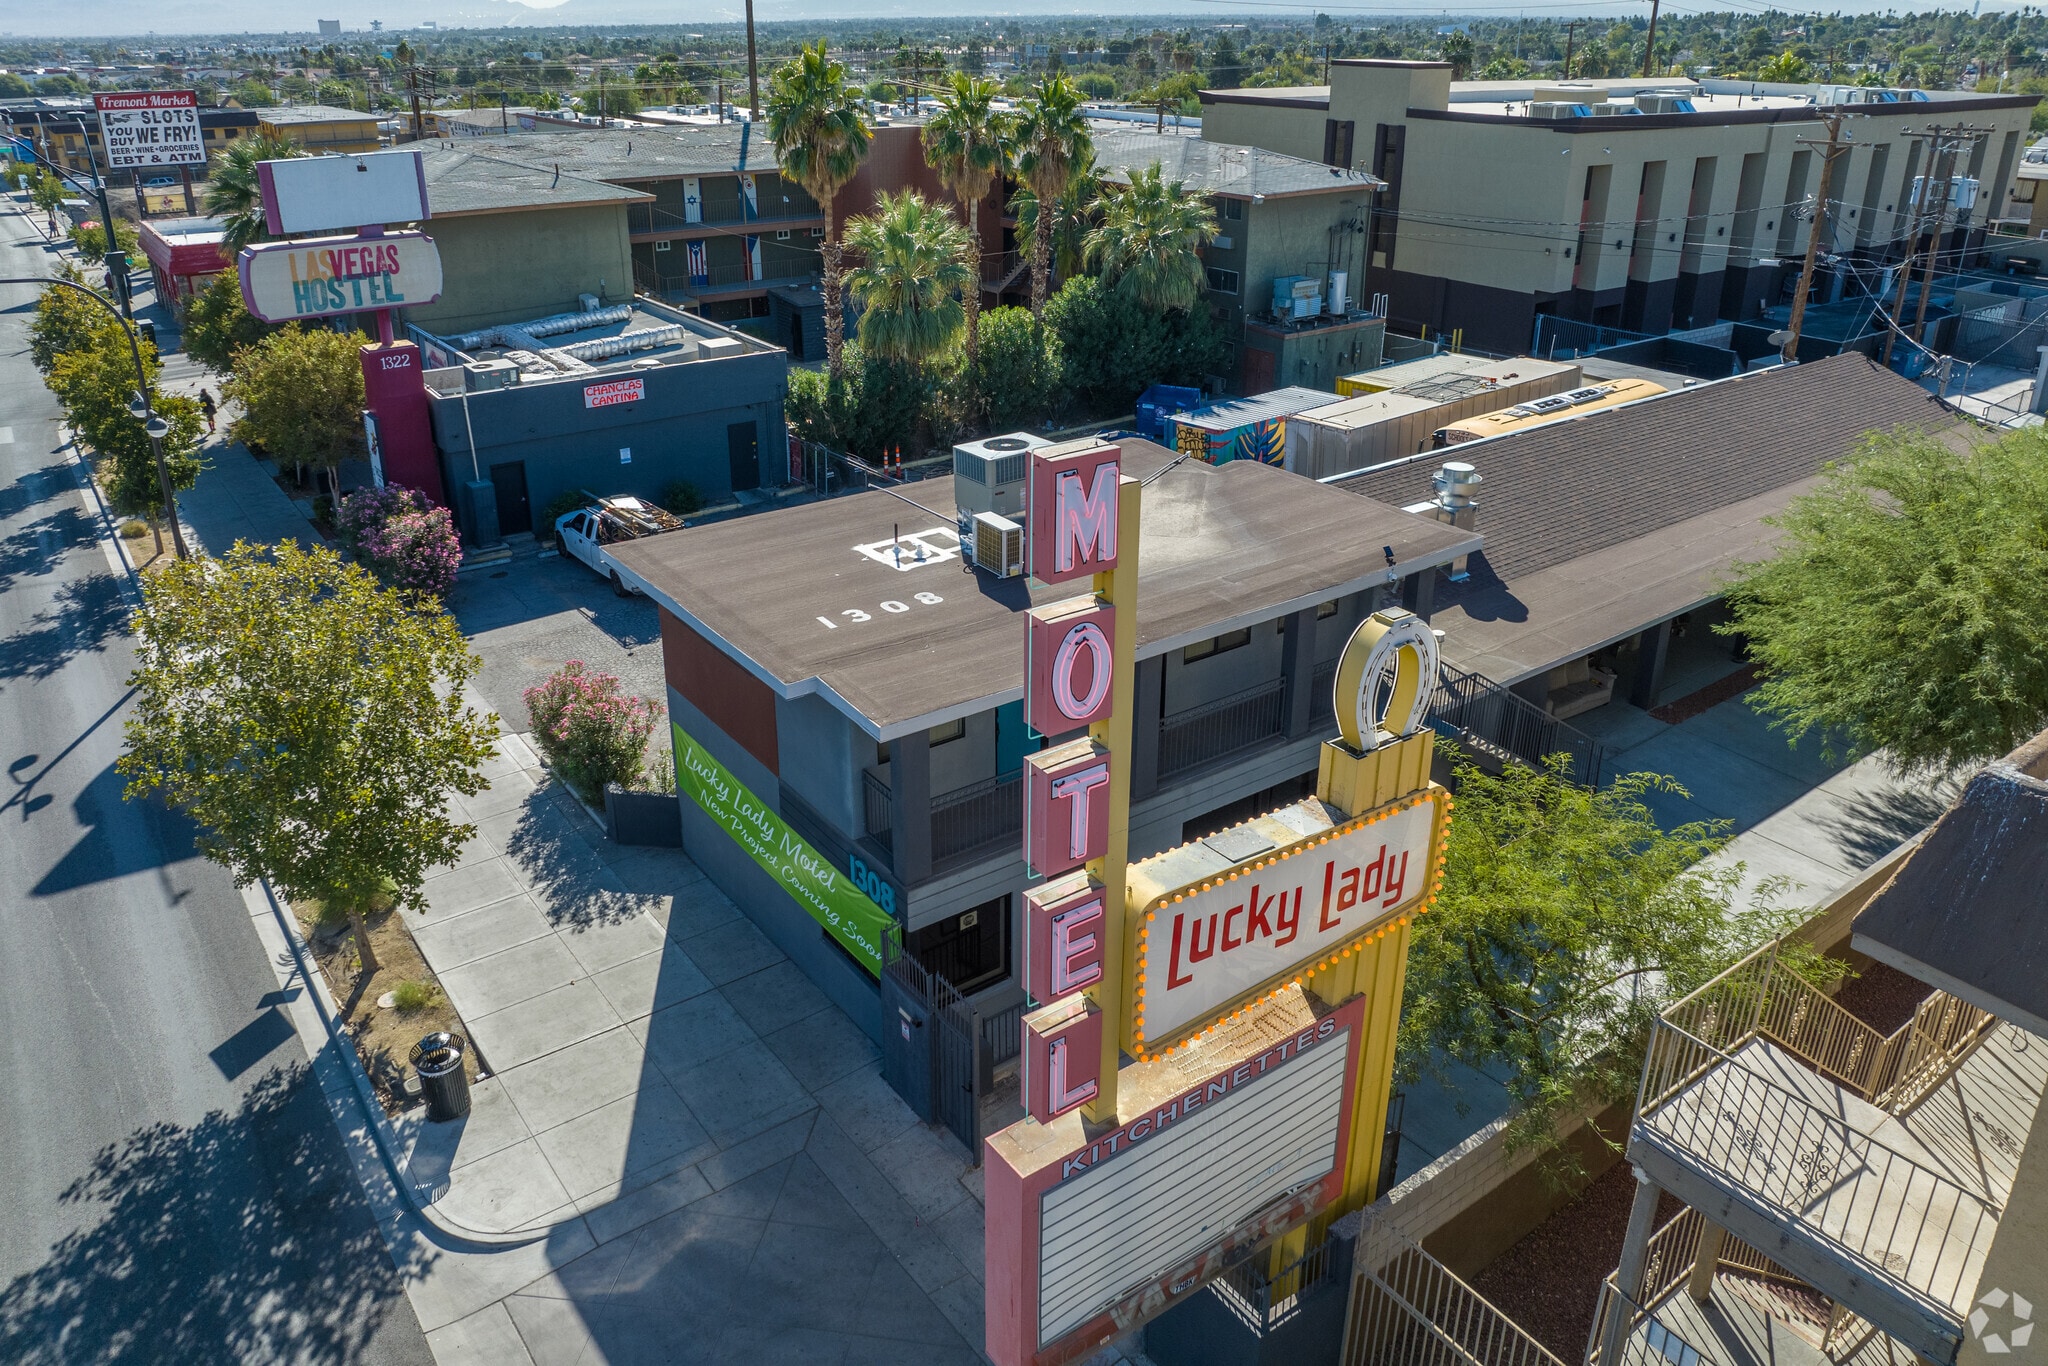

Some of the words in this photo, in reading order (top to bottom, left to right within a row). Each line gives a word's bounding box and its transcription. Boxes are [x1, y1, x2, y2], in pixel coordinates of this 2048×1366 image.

[101, 96, 149, 108] Fremont
[150, 95, 191, 107] Market
[141, 109, 194, 124] SLOTS
[107, 127, 133, 136] YOU
[136, 127, 159, 143] WE
[164, 126, 197, 142] FRY!
[110, 137, 135, 146] BUY
[159, 144, 200, 152] GROCERIES
[112, 155, 144, 165] EBT
[151, 154, 162, 163] &
[169, 152, 202, 162] ATM
[292, 270, 405, 314] HOSTEL
[380, 354, 411, 370] 1322
[586, 380, 642, 396] CHANCLAS
[591, 391, 639, 407] CANTINA
[815, 592, 944, 629] 1308
[1049, 461, 1118, 1115] MOTEL
[685, 747, 729, 803] Lucky
[734, 789, 776, 845] Lady
[779, 832, 836, 893] Motel
[700, 788, 728, 820] New
[730, 814, 779, 869] Project
[781, 865, 841, 929] Coming
[850, 854, 896, 915] 1308
[1167, 884, 1302, 991] Lucky
[1318, 844, 1409, 933] Lady
[1062, 1017, 1336, 1181] KITCHENETTES
